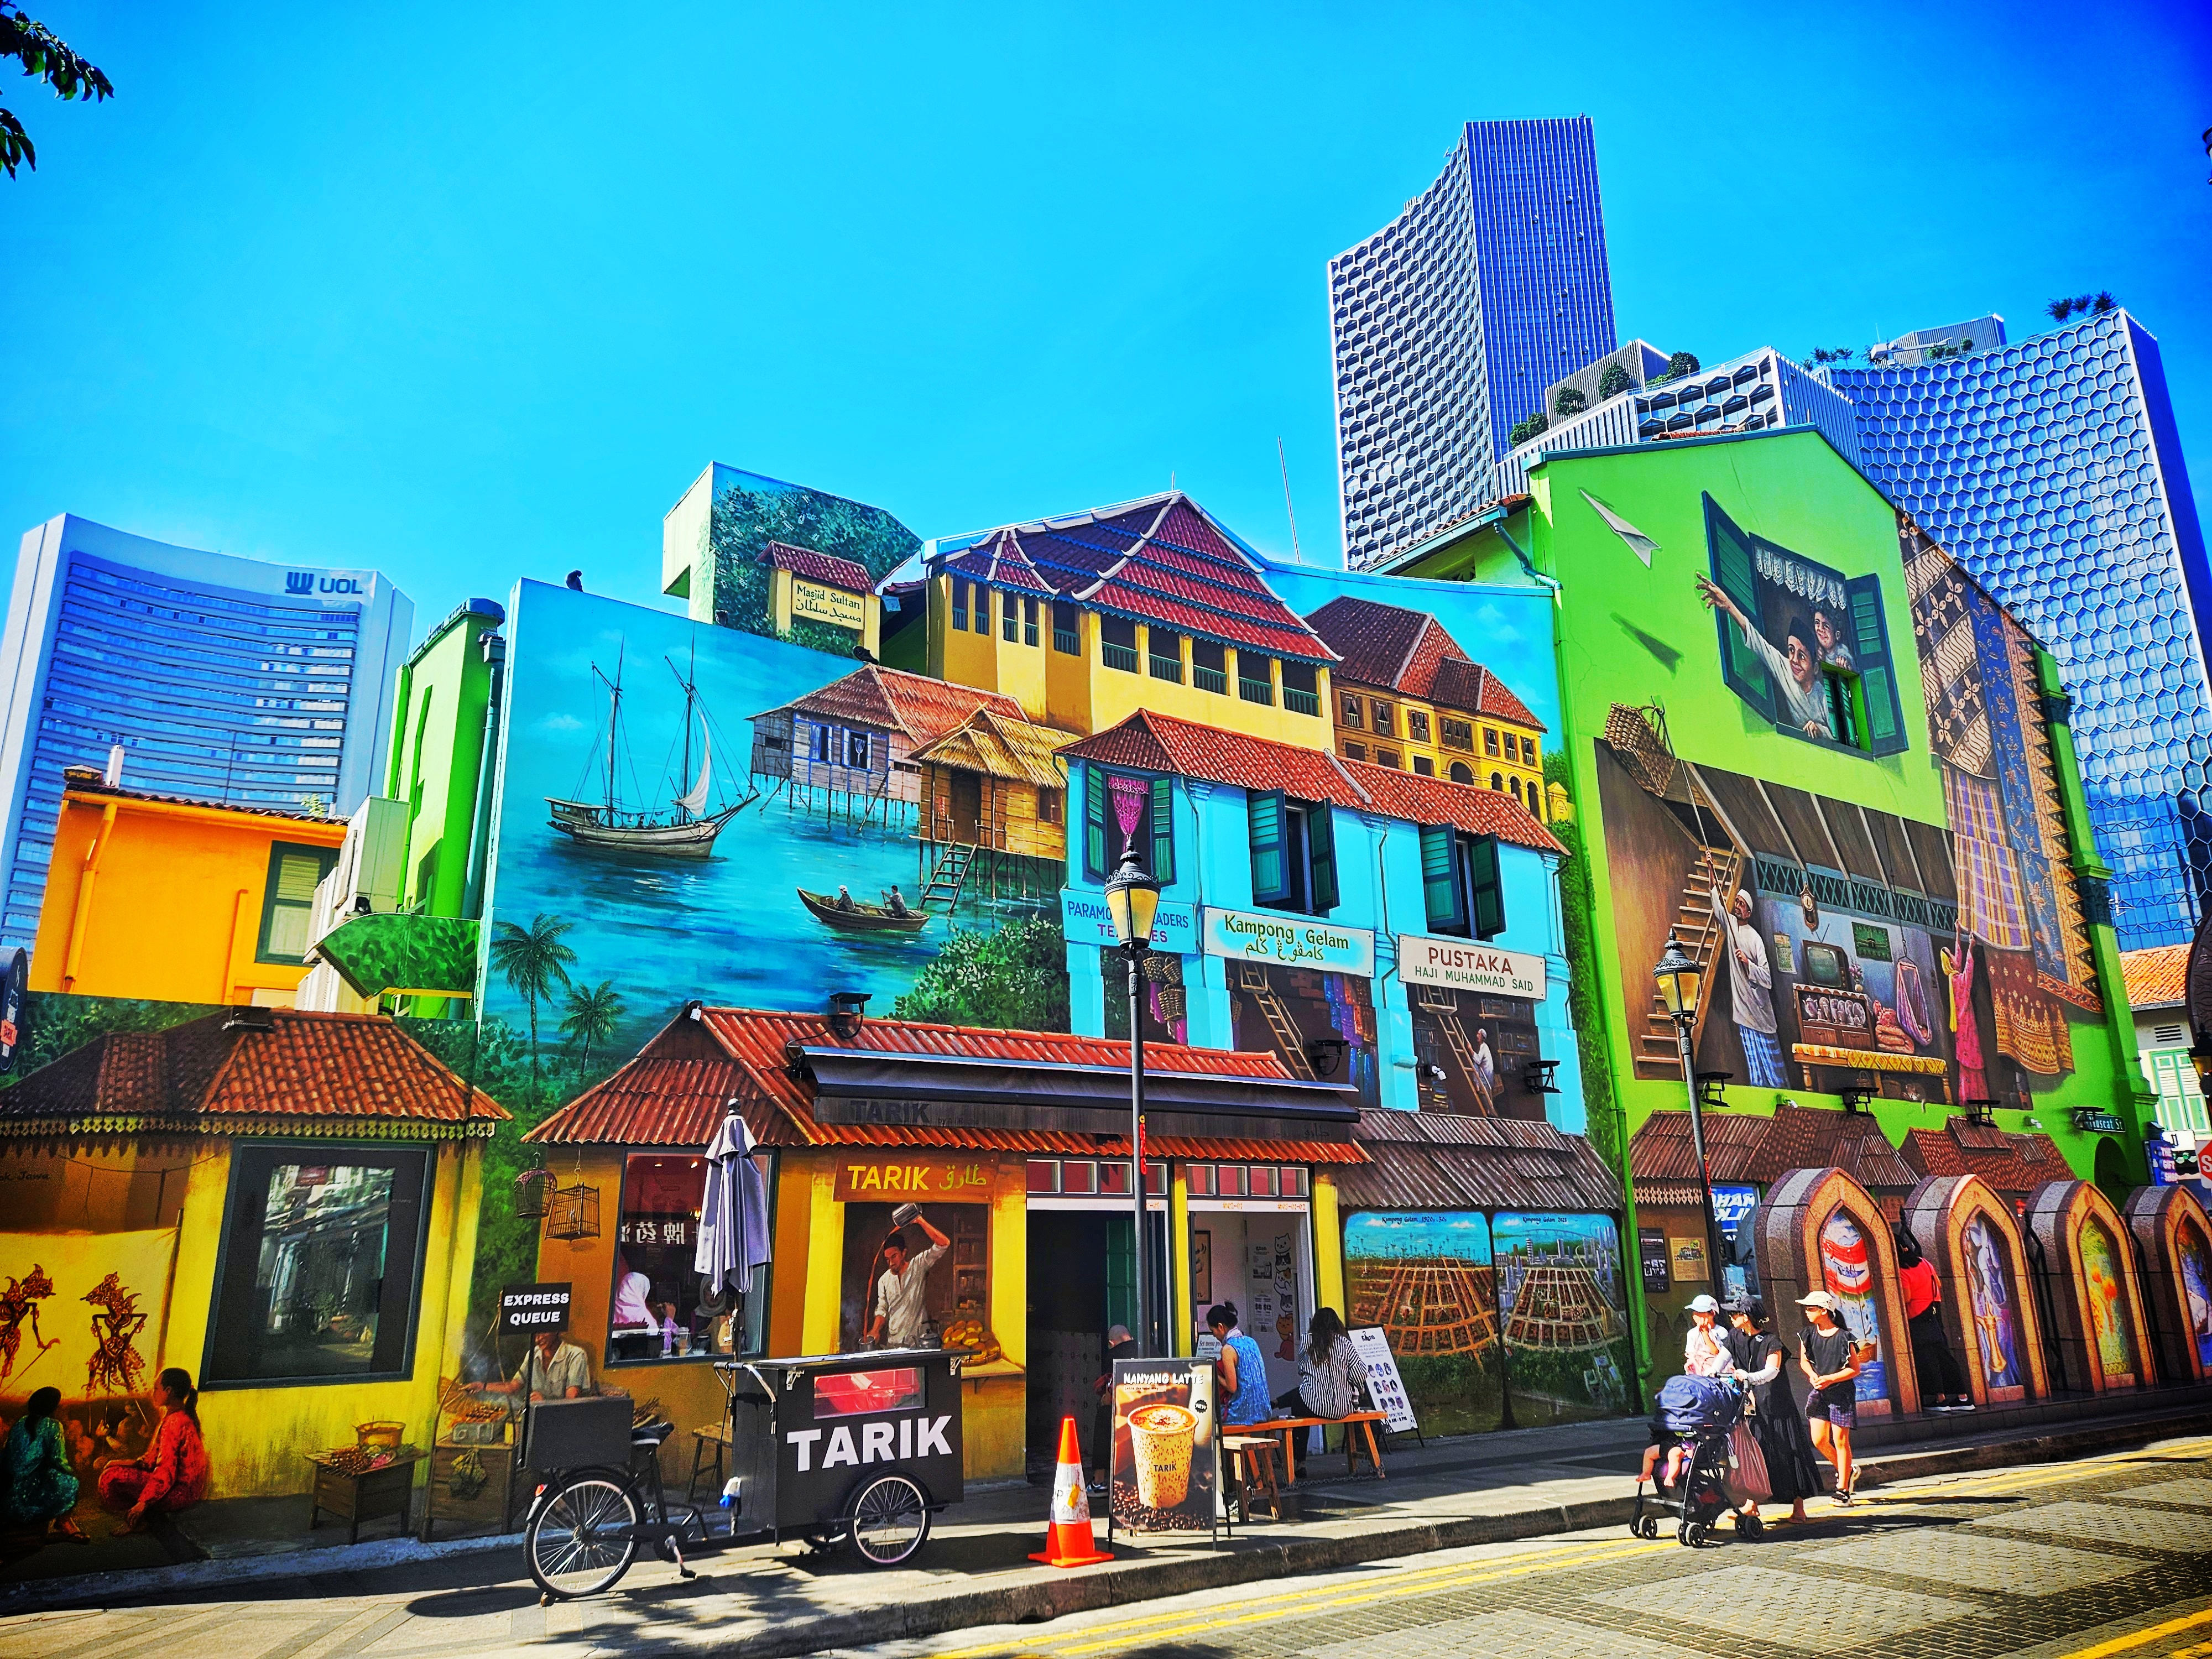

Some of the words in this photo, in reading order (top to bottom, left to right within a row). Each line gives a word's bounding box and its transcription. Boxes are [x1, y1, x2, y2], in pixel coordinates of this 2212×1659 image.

[319, 577, 363, 594] UOL
[796, 598, 828, 614] سلطان
[797, 584, 825, 601] Masjid
[831, 593, 860, 609] Sultan
[830, 607, 862, 622] مسجد
[1225, 914, 1294, 944] Kampong
[1306, 929, 1349, 950] Gelam
[1428, 947, 1514, 976] PUSTAKA
[1415, 966, 1438, 978] HAJI
[1446, 970, 1505, 988] MUHAMMAD
[1512, 978, 1533, 992] SAID
[850, 1100, 930, 1124] TARIK
[2115, 1118, 2124, 1130] St
[847, 1165, 930, 1191] TARIK
[939, 1164, 987, 1191] طارق
[504, 1292, 569, 1306] EXPRESS
[510, 1311, 561, 1326] QUEUE
[1123, 1372, 1170, 1385] NANYANG
[1172, 1372, 1204, 1385] LATTE
[786, 1415, 953, 1472] TARIK
[1154, 1464, 1177, 1472] TARIK
